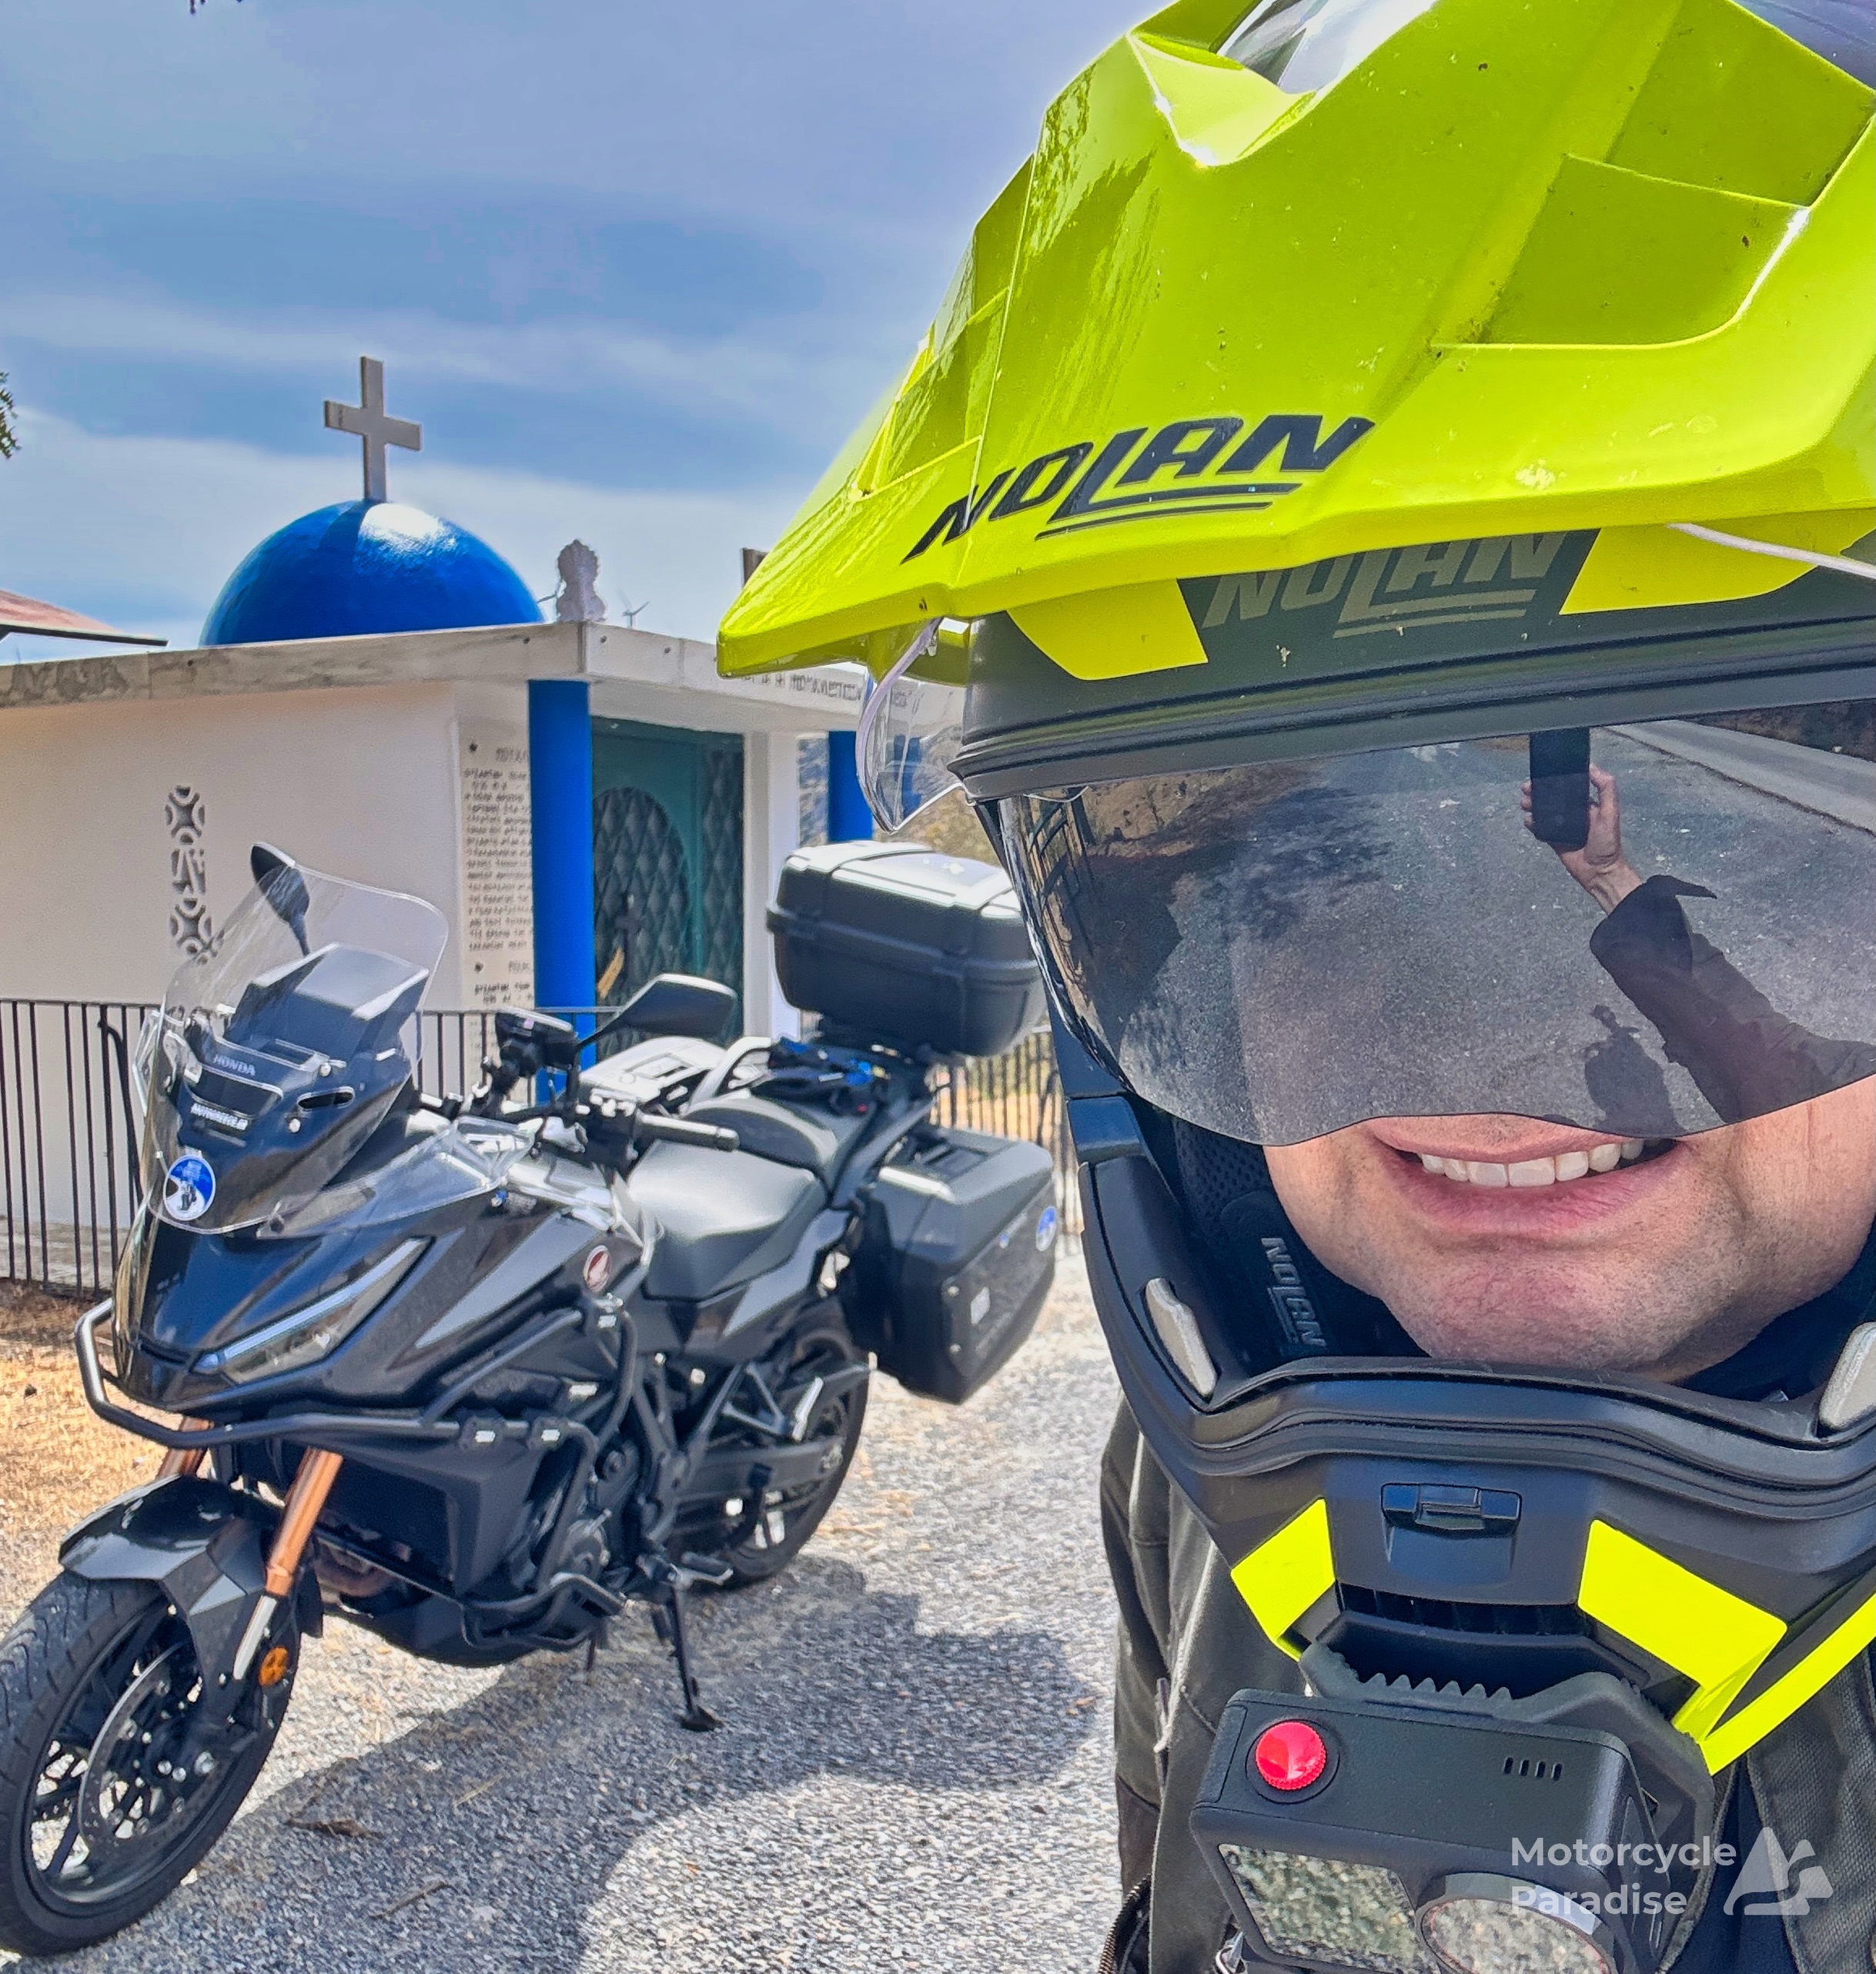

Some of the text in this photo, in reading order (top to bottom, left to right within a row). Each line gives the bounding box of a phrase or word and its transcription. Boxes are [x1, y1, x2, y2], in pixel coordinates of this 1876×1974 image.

[900, 413, 1376, 564] NOLAN
[212, 1055, 256, 1076] HONDA
[1261, 1238, 1327, 1347] NOLAN
